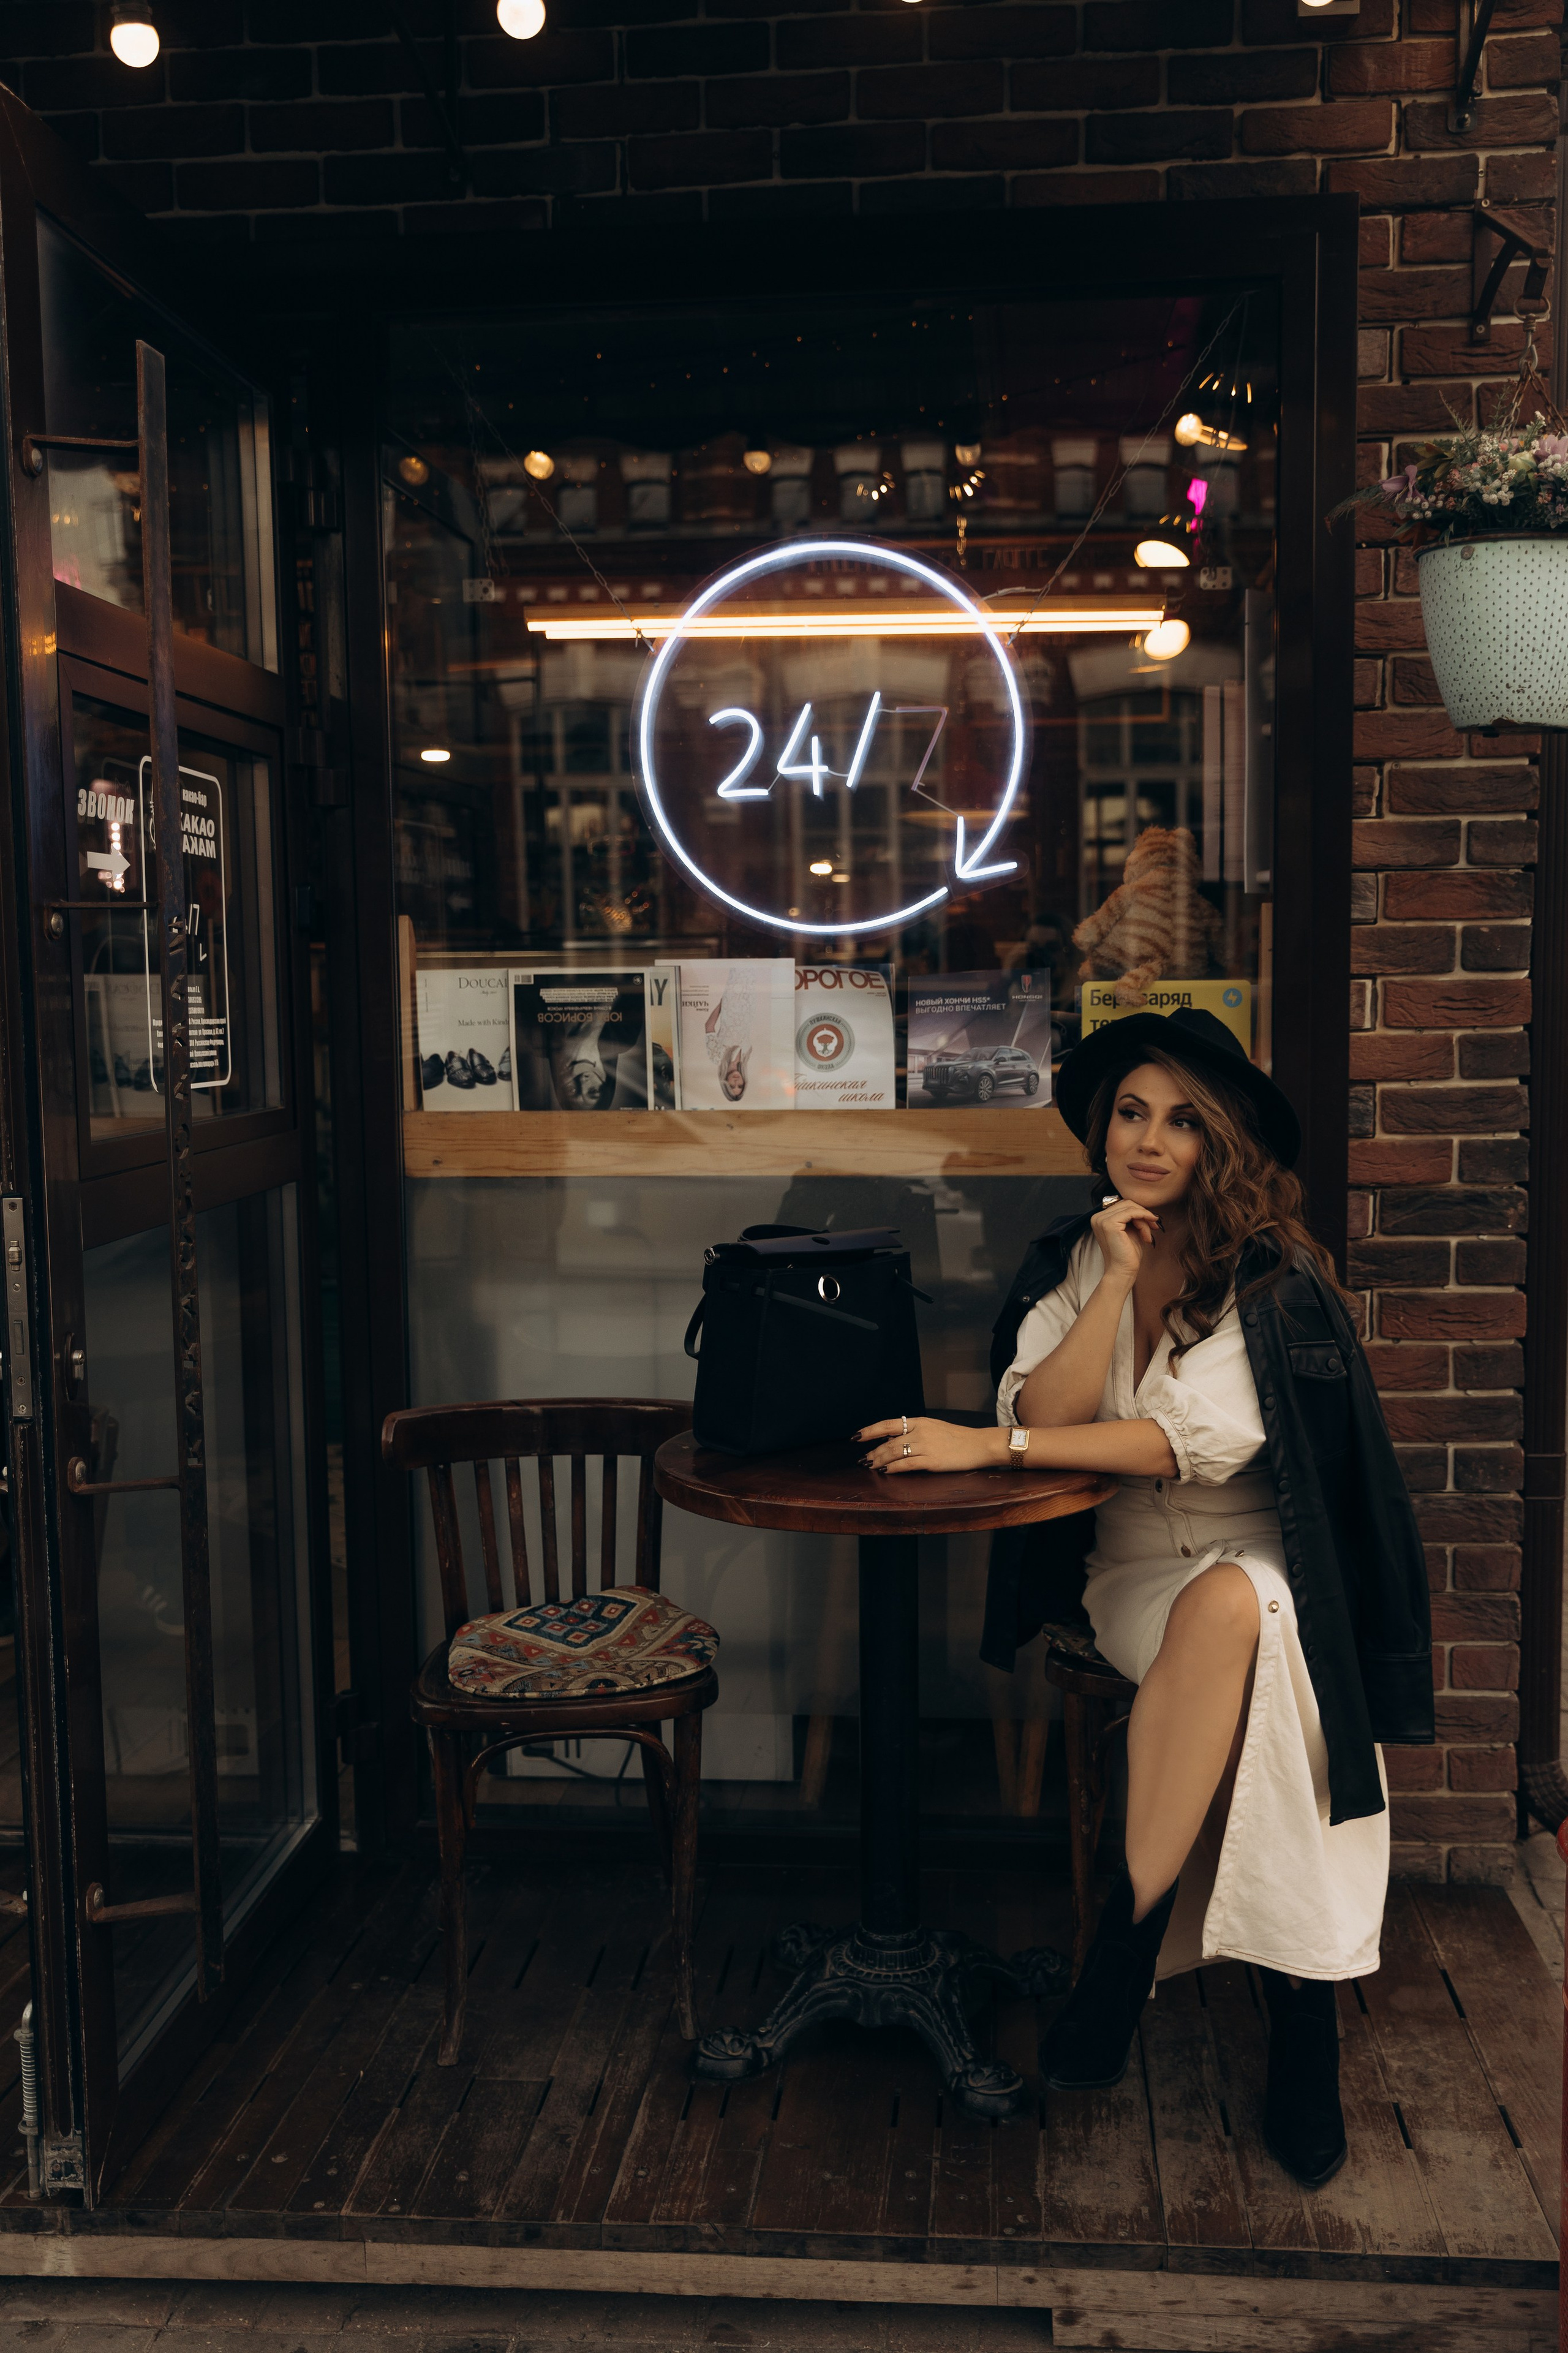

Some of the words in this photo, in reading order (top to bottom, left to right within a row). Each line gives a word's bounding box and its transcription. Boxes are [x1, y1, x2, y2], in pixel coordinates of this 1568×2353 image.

[709, 690, 948, 798] 24/7
[77, 788, 135, 825] ЗВОНОК
[915, 997, 943, 1007] НОВЫЙ
[1090, 989, 1120, 1009] Бер
[915, 1005, 954, 1014] ВЫГОДНО
[956, 1003, 1006, 1011] ВПЕЧАТЛЯЕТ
[538, 1012, 593, 1023] БОРИСОВ
[838, 1092, 884, 1102] школа
